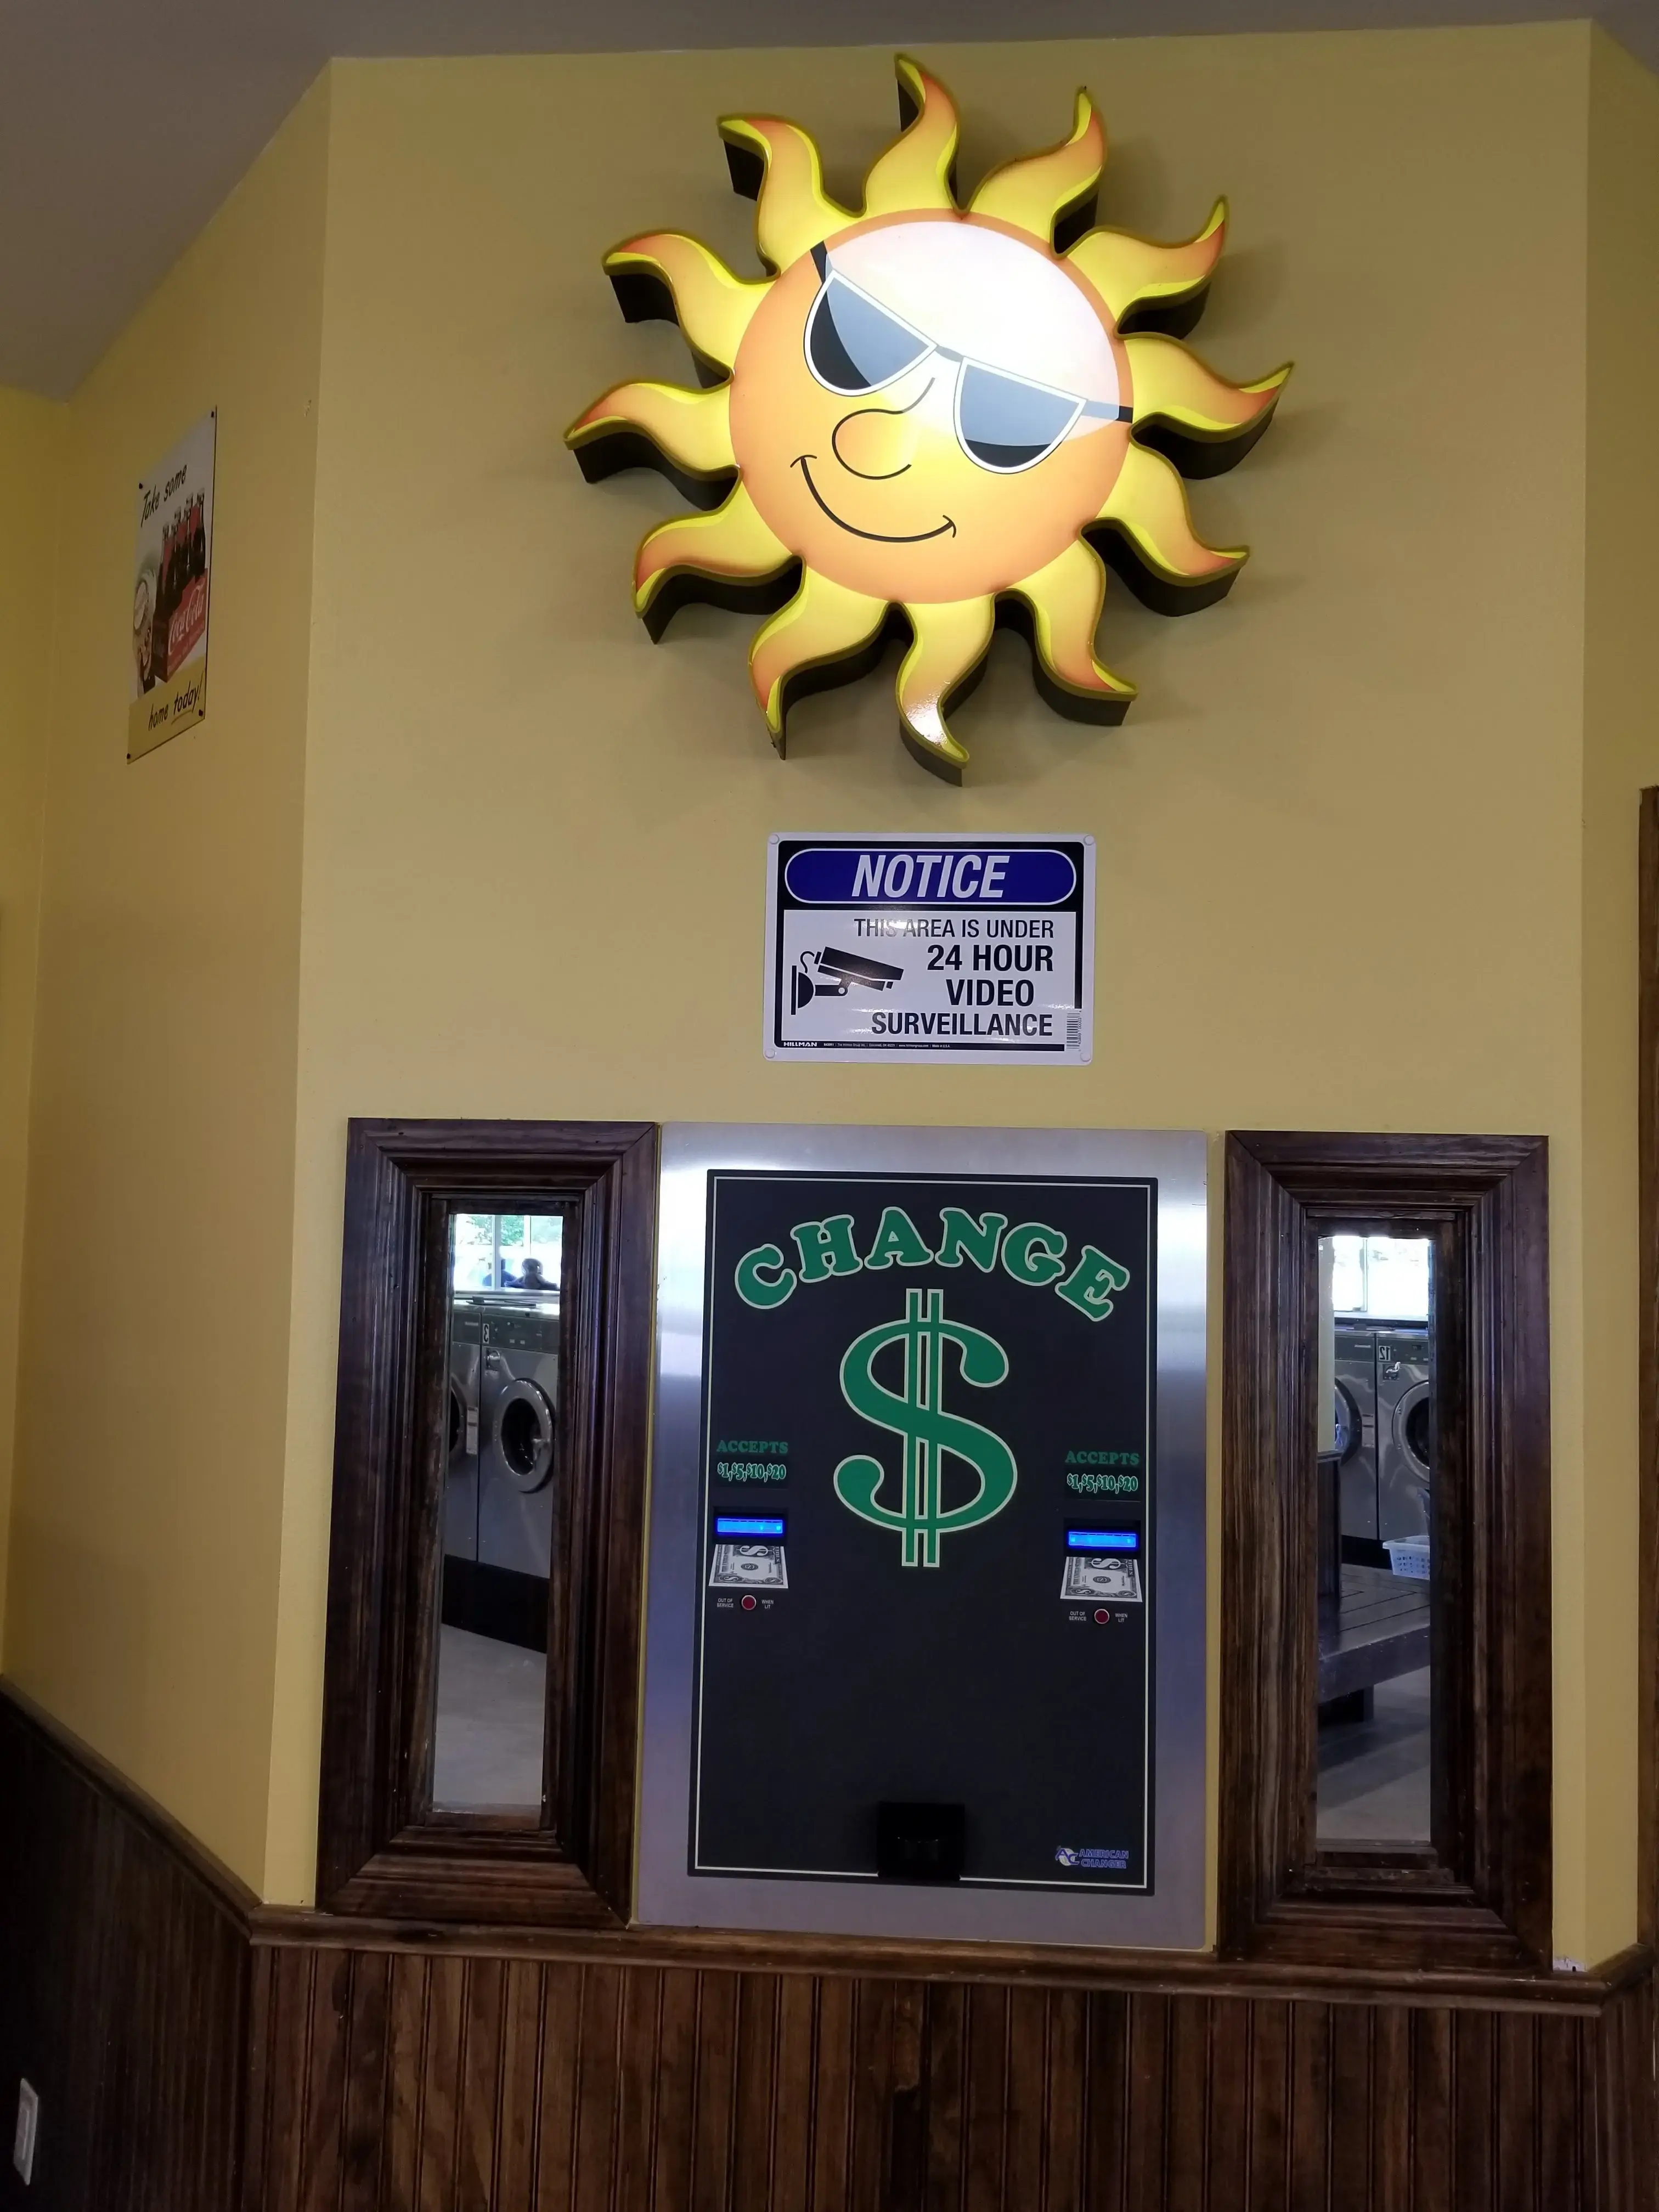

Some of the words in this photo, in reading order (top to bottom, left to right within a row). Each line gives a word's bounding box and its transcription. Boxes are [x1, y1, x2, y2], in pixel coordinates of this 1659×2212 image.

[140, 484, 160, 527] Take
[164, 465, 187, 501] some
[148, 704, 168, 731] home
[173, 670, 204, 713] today!
[851, 854, 1010, 898] NOTICE
[854, 918, 898, 937] THIS
[903, 919, 955, 938] AREA
[962, 919, 979, 938] IS
[987, 919, 1054, 938] UNDER
[927, 945, 963, 970] 24
[973, 945, 1053, 972] HOUR
[946, 979, 1034, 1006] VIDEO
[871, 1012, 1052, 1036] SURVEILLANCE
[735, 1206, 1130, 1322] CHANGE
[833, 1288, 1018, 1568] $
[716, 1440, 788, 1454] ACCEPTS
[1065, 1451, 1139, 1465] ACCEPTS
[1079, 1848, 1129, 1859] AMERICAN
[1081, 1859, 1126, 1869] CHANGER
